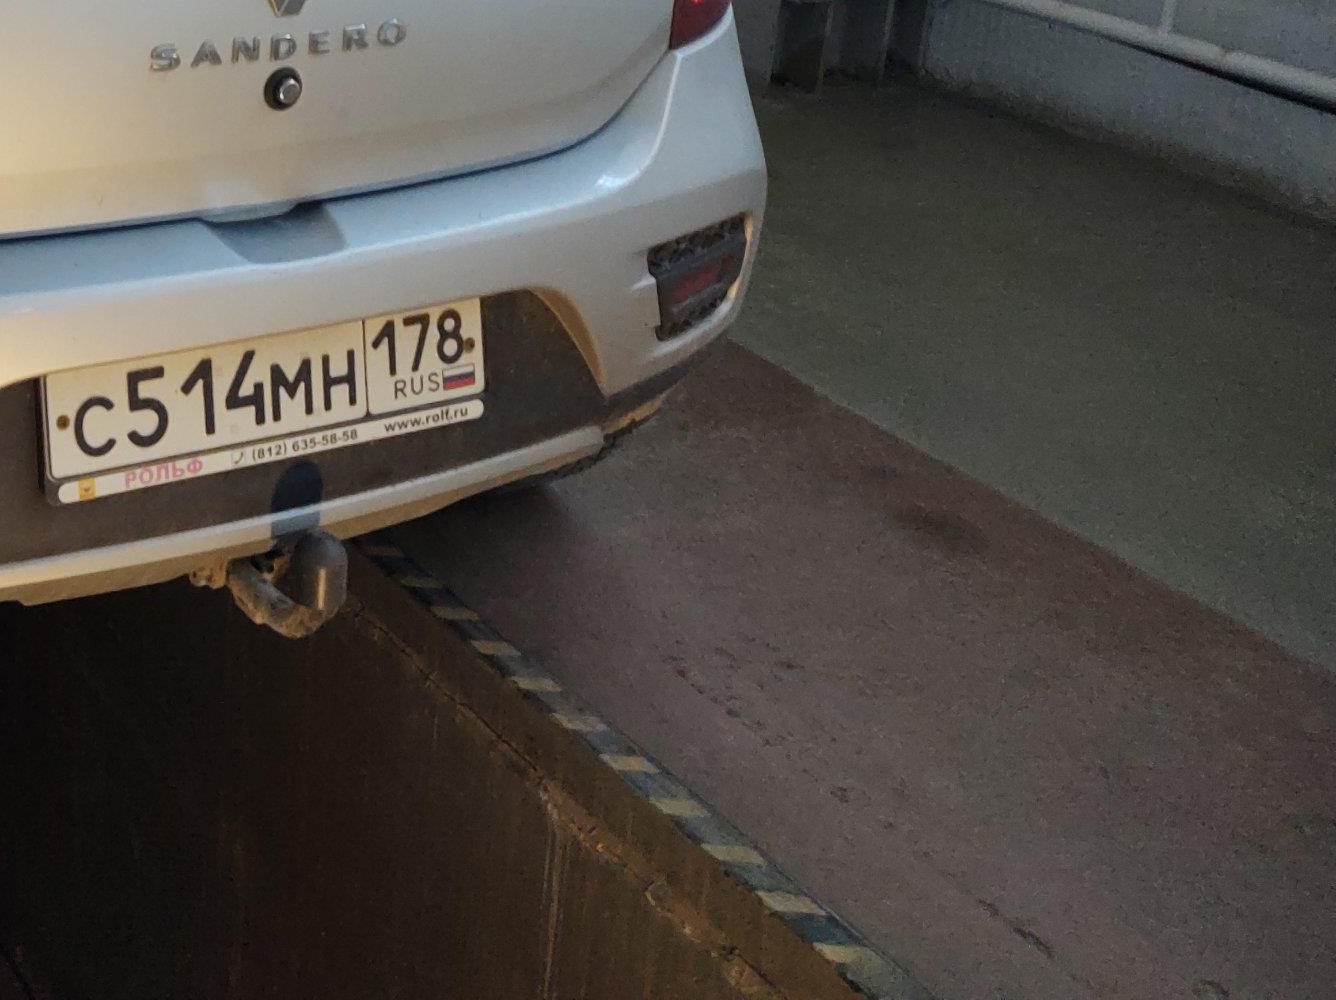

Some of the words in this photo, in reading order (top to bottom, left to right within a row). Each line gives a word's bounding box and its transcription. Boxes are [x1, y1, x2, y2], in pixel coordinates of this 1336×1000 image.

[150, 18, 407, 73] SANDERO
[372, 309, 464, 377] 178
[394, 372, 440, 400] RUS
[124, 457, 205, 490] РОЛЬФ
[292, 429, 359, 453] 635-58-58
[383, 406, 469, 433] www.rolf.ru
